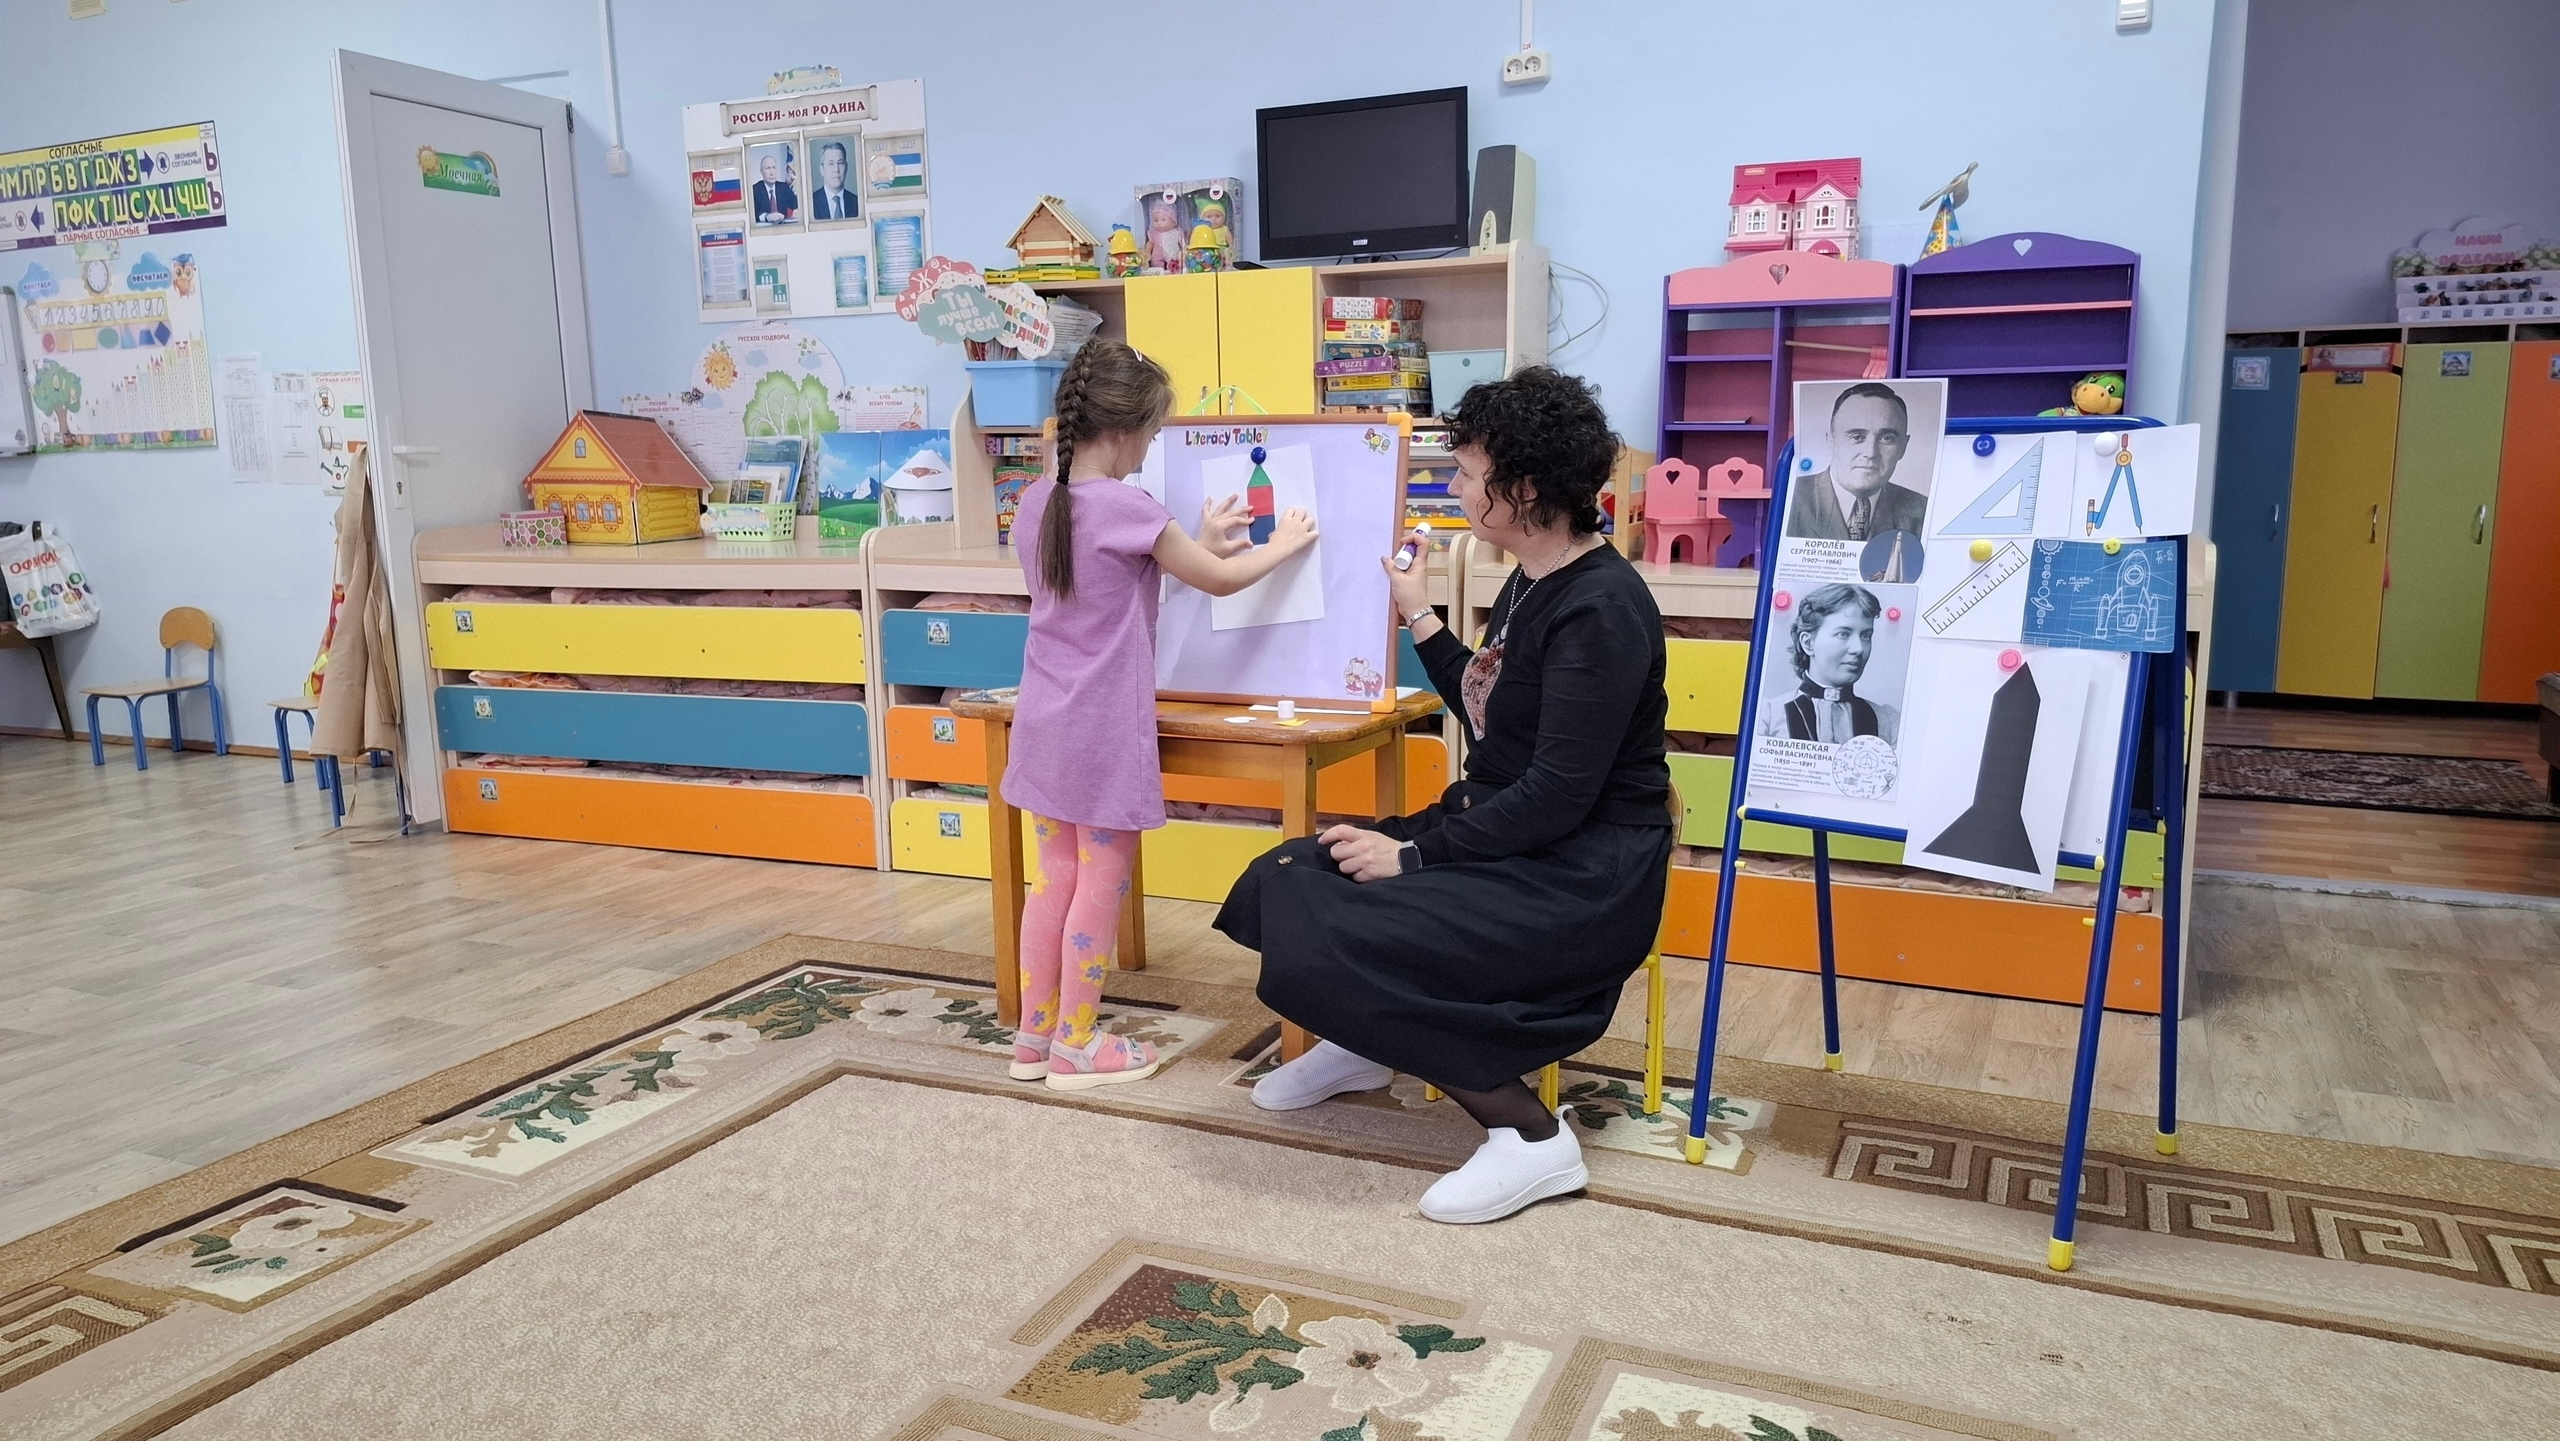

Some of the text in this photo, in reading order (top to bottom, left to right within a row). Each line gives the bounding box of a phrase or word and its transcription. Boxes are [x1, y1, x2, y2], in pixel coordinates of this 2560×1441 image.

[813, 100, 866, 115] РОДИНА
[49, 141, 103, 159] СОГЛАСНЫЕ
[172, 158, 202, 168] СОГЛАСНЫЕ
[438, 163, 482, 182] Моечная
[63, 227, 140, 243] ПАРНЫЕ СОГЛАСНЫЕ
[2455, 234, 2502, 246] НАШИ
[132, 272, 169, 282] ПОСЧИТАЕМ
[937, 306, 980, 326] лучше
[954, 312, 1000, 336] всех!
[737, 333, 790, 342] РУССКОЕ ПОДВОРЬЕ
[1339, 360, 1368, 368] PUZZLE
[1186, 430, 1231, 446] Literacy
[1805, 540, 1845, 550] КОРОЛЁВ
[1790, 548, 1857, 559] СЕРГЕЙ ПАВЛОВИЧ
[1766, 739, 1829, 752] КОВАЛЕВСКАЯ
[1785, 750, 1832, 761] ВАСИЛЬЕВНА
